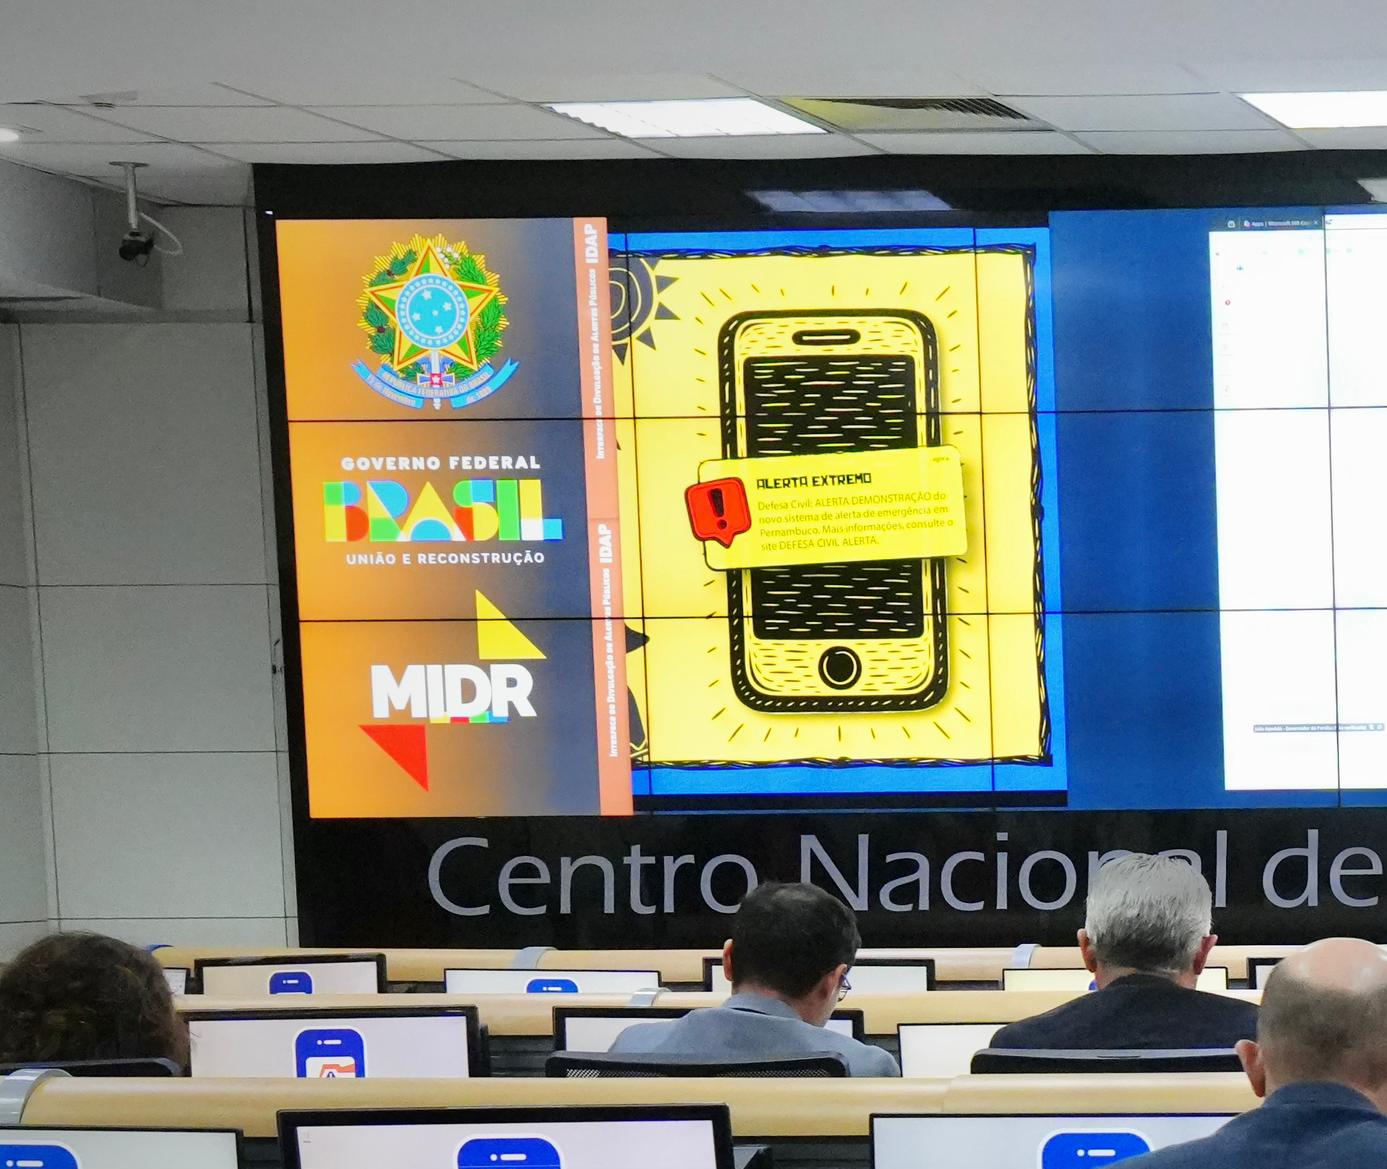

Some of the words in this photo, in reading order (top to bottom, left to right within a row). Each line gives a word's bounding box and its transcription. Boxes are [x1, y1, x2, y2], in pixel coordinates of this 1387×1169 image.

[584, 223, 599, 264] IDAP
[340, 456, 441, 471] GOVERNO
[449, 455, 541, 471] FEDERAL
[757, 477, 808, 490] ALERTA
[812, 473, 872, 487] EXTREMO
[322, 478, 564, 542] BRASIL
[758, 500, 788, 512] Defesa
[815, 496, 850, 507] ALERTA
[852, 491, 932, 506] DEMONSTRAÇÃO
[934, 492, 946, 501] do
[759, 515, 784, 525] novo
[786, 512, 819, 523] sistema
[821, 511, 833, 521] de
[835, 509, 862, 520] alerta
[863, 509, 875, 519] de
[877, 505, 931, 519] emergência
[934, 506, 949, 515] em
[822, 524, 844, 535] Mais
[906, 518, 946, 529] consulte
[947, 519, 954, 527] o
[598, 524, 613, 564] IDAP
[761, 541, 778, 552] site
[779, 539, 815, 551] DEFESA
[816, 538, 840, 548] CIVIL
[346, 552, 396, 565] UNIÃO
[402, 554, 411, 565] E
[417, 550, 545, 566] RECONSTRUÇÃO
[370, 663, 537, 719] MIDR
[427, 836, 758, 916] Centro
[1262, 830, 1384, 910] de
